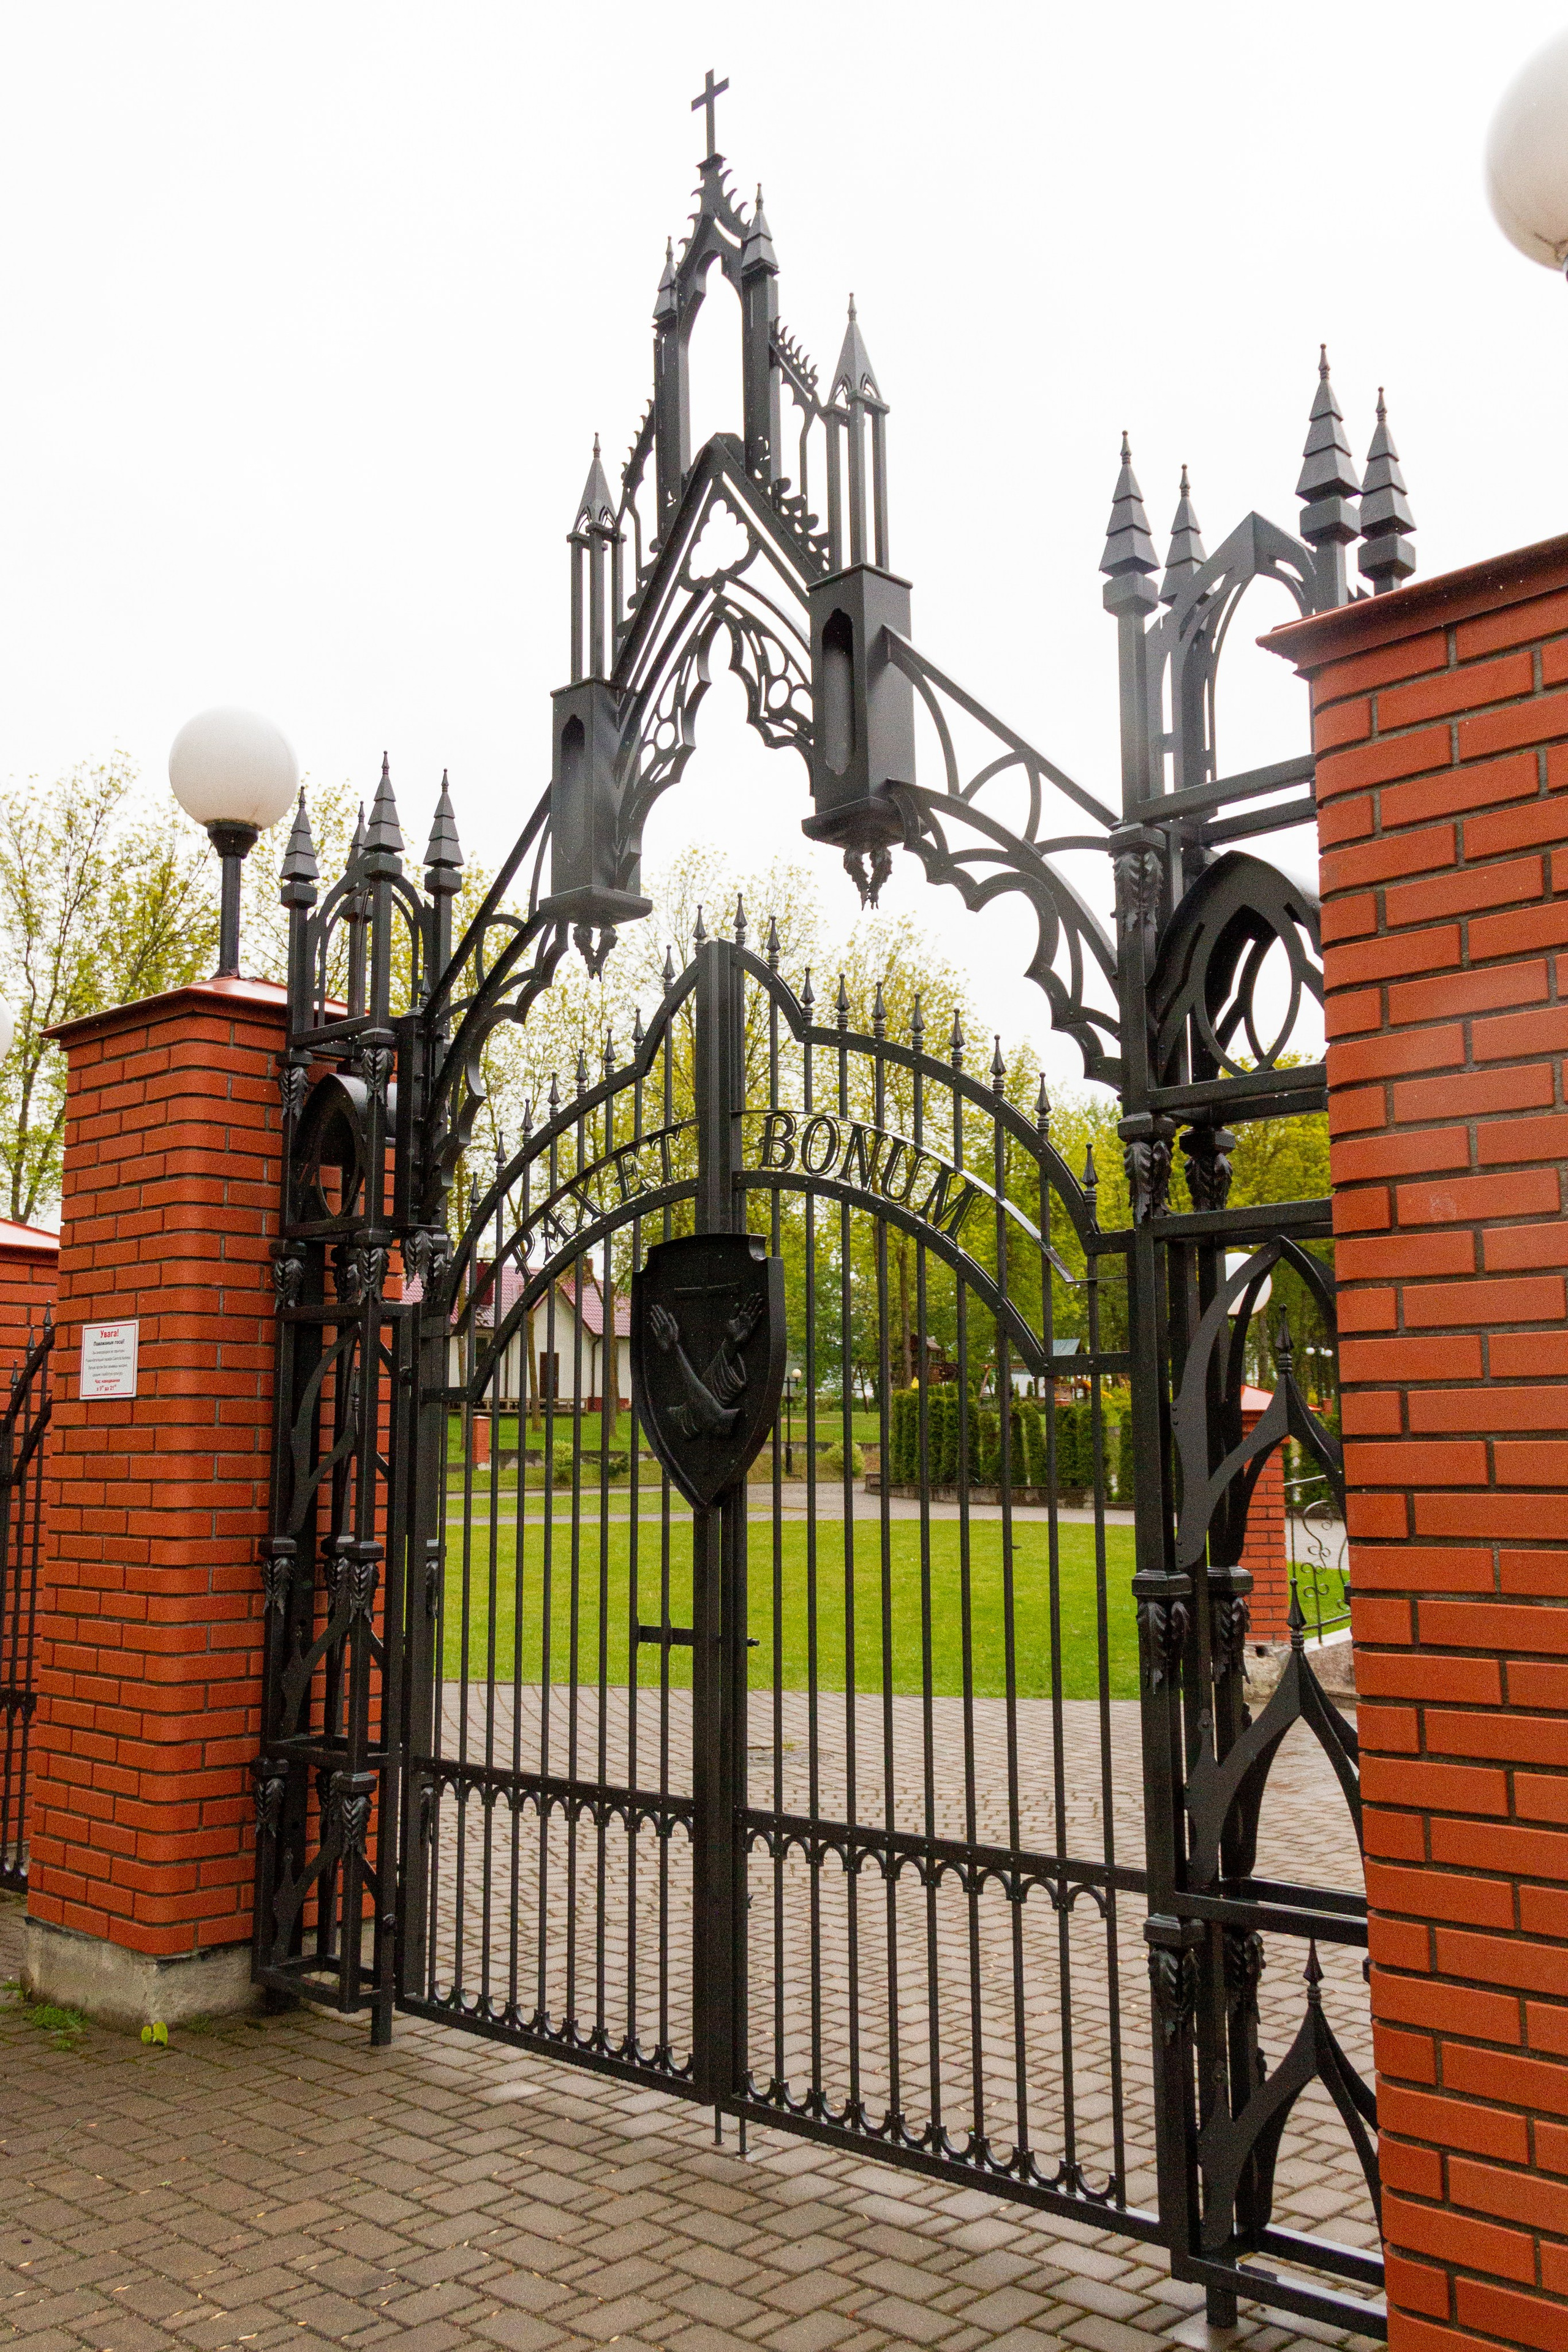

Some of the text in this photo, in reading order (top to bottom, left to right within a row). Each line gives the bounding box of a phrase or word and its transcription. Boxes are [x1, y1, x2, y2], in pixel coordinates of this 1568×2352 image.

[512, 1111, 982, 1287] PAX ET BONUM
[100, 1329, 119, 1338] Увага!
